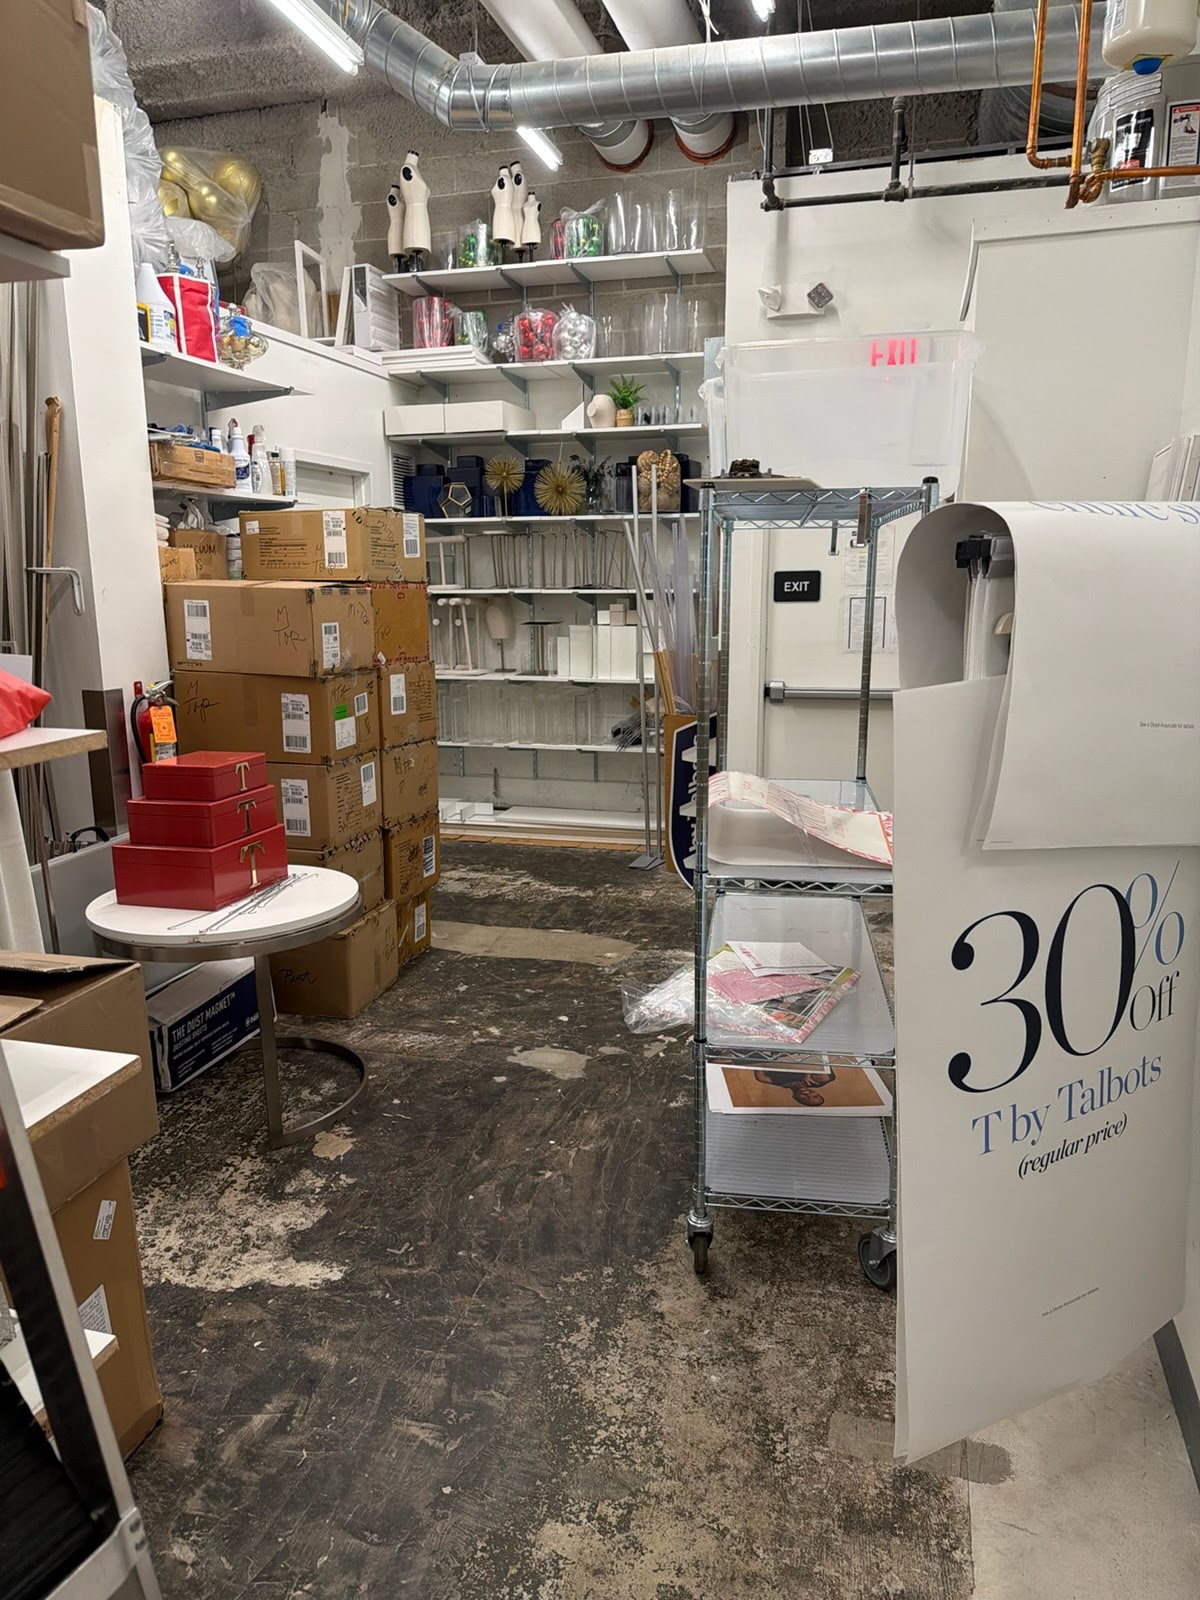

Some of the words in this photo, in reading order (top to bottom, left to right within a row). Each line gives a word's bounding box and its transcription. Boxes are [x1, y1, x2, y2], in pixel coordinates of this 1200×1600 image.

[784, 581, 810, 592] EXIT
[235, 761, 250, 791] T
[237, 799, 257, 832] T
[240, 840, 266, 889] T
[1130, 970, 1180, 1031] off
[172, 1024, 186, 1043] THE
[186, 1012, 204, 1033] DUST
[971, 1110, 1002, 1156] T
[1009, 1103, 1051, 1146] by
[1058, 1056, 1162, 1124] Talbots
[1018, 1137, 1084, 1180] (regular
[1084, 1112, 1128, 1154] price)
